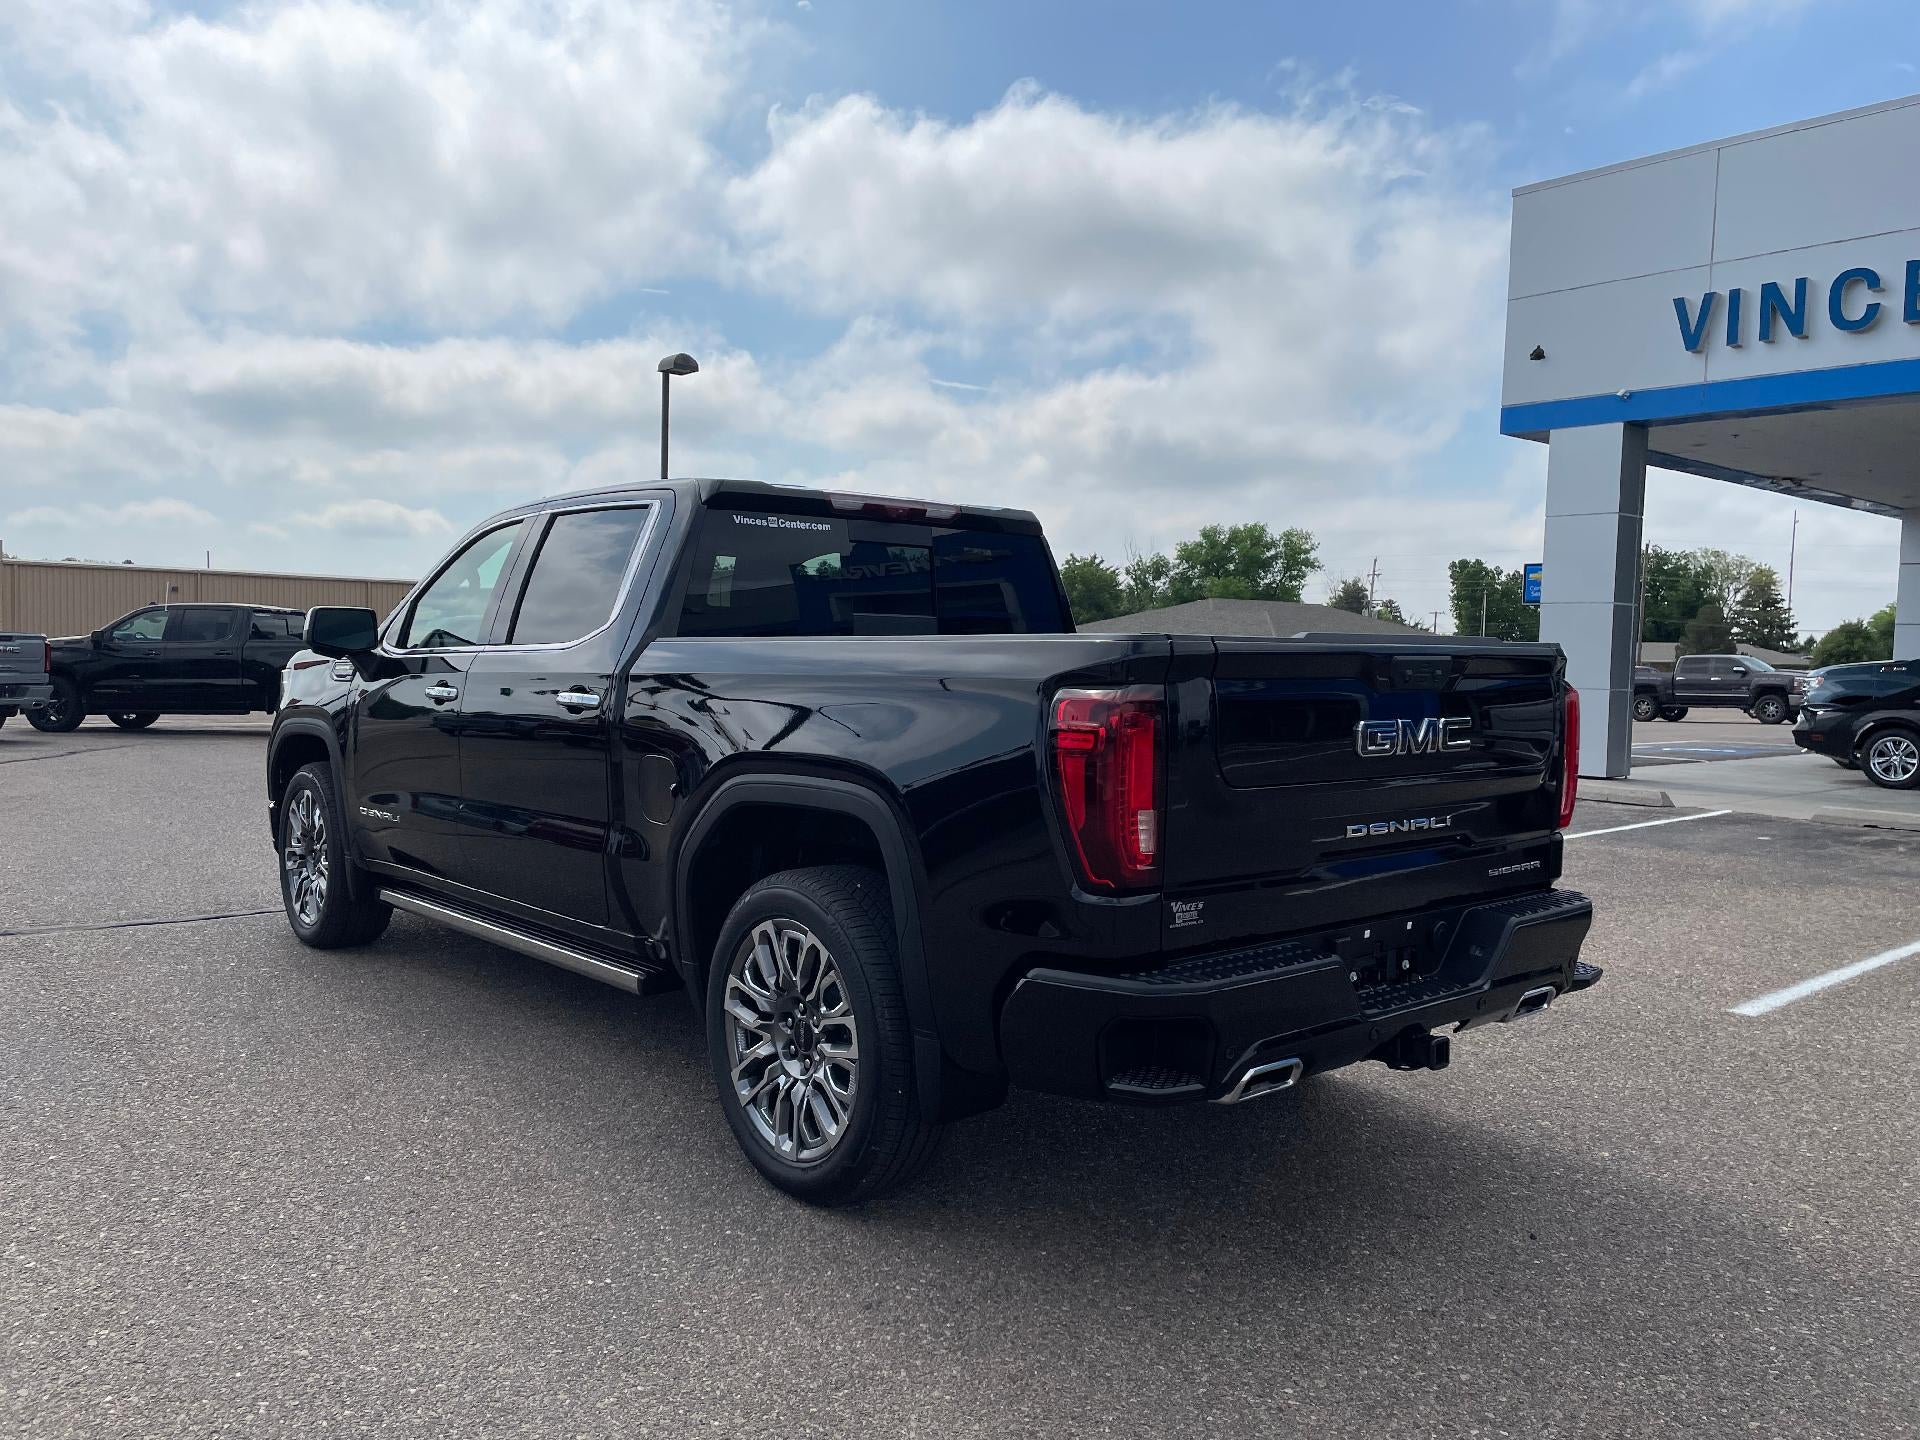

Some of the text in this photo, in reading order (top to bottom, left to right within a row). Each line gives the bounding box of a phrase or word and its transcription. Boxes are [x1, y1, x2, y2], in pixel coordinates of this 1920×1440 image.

[778, 519, 831, 531] Center.com
[1356, 717, 1472, 757] GMC
[359, 806, 400, 823] DENALI
[1346, 815, 1452, 839] DENALI
[1488, 860, 1541, 877] SIERRA
